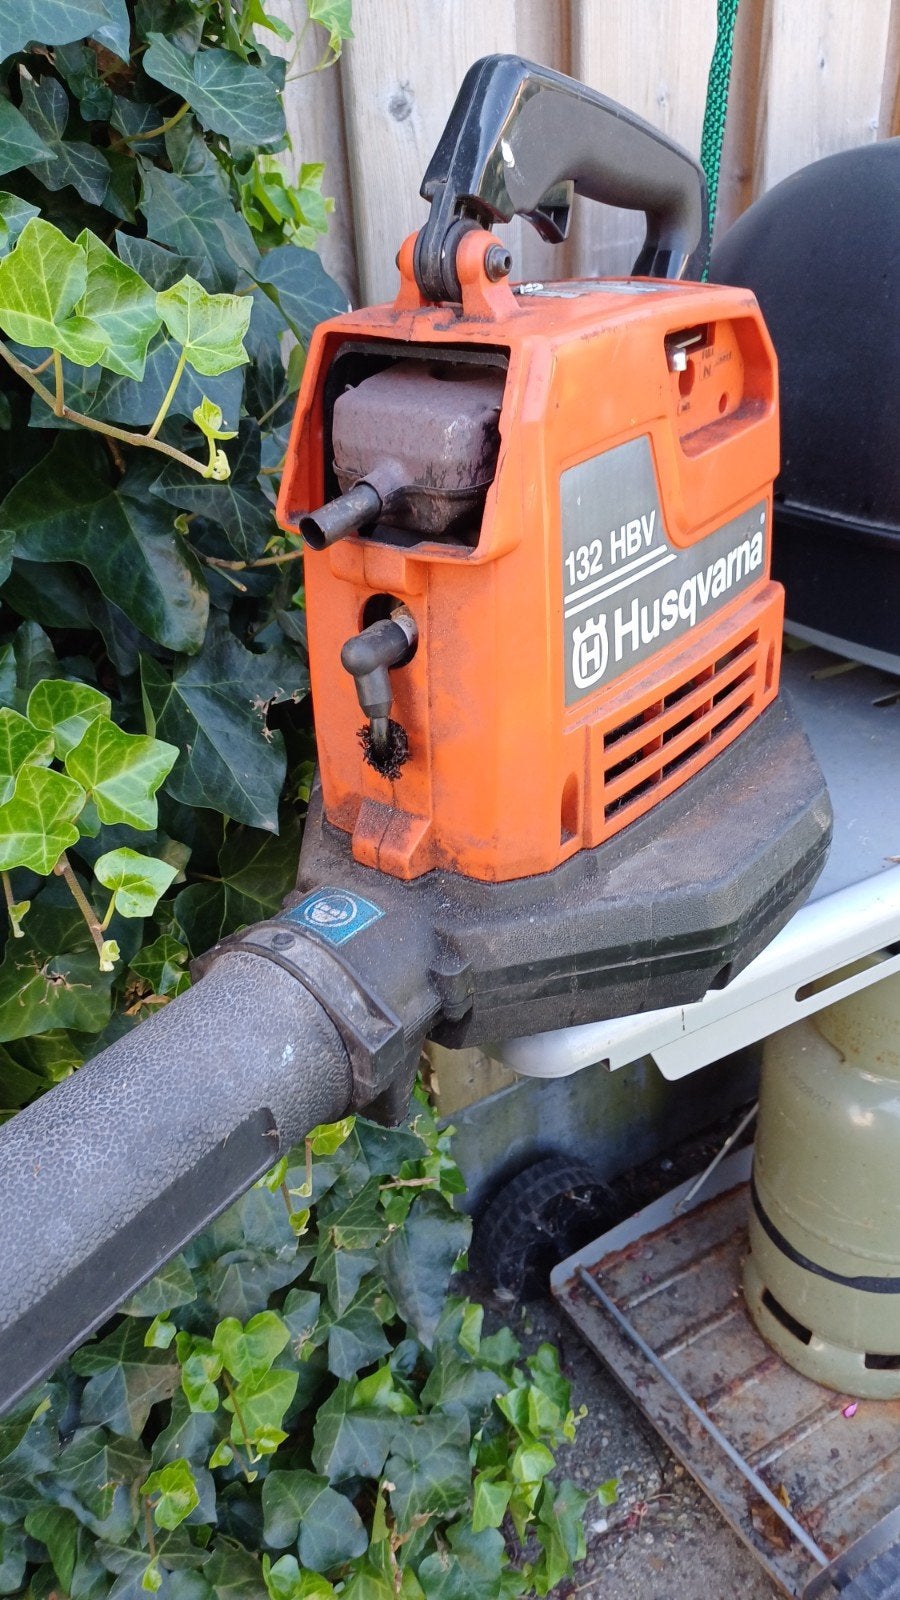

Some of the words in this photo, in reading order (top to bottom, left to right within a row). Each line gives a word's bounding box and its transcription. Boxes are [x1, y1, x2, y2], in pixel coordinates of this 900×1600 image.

[565, 539, 603, 586] 132
[610, 510, 656, 565] HBV
[614, 531, 763, 662] Husqvarna
